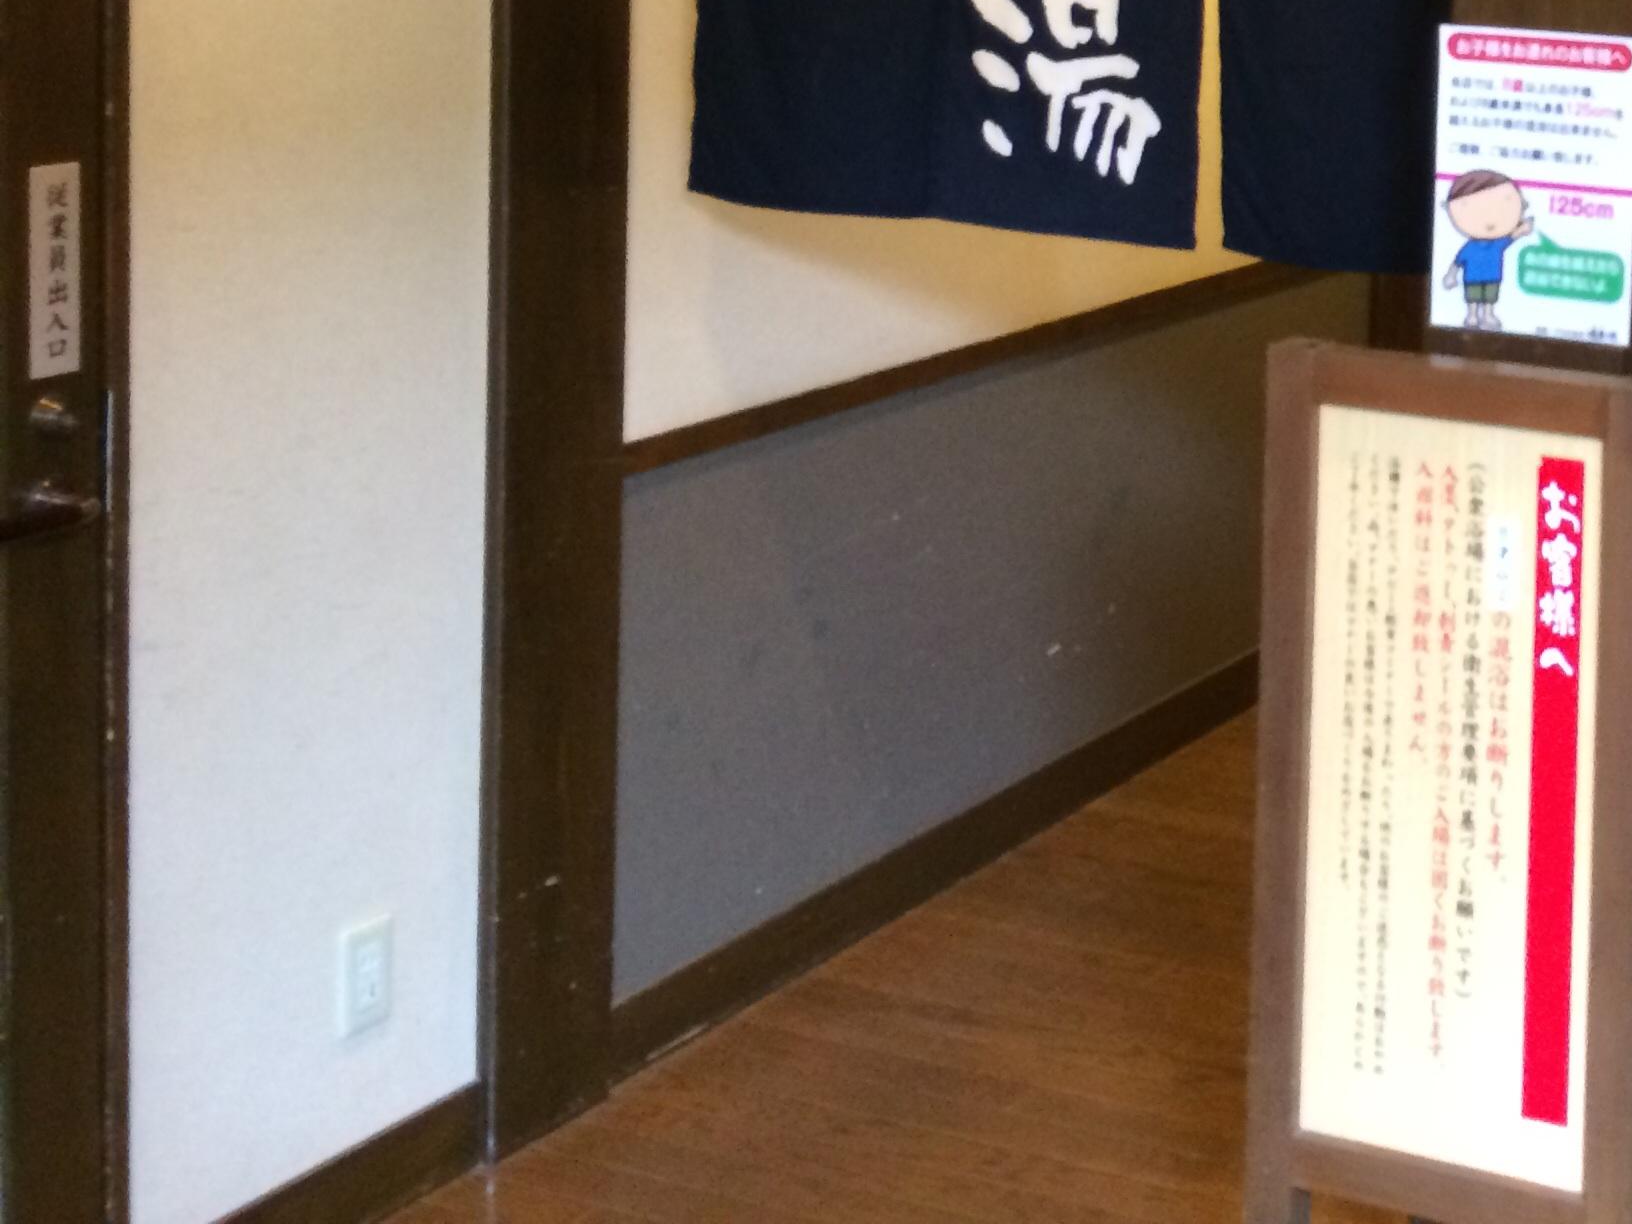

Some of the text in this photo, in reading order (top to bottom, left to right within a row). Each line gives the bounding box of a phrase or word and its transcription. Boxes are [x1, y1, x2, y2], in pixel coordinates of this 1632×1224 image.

[1548, 195, 1615, 219] 125cm
[1539, 481, 1581, 676] お客様へ
